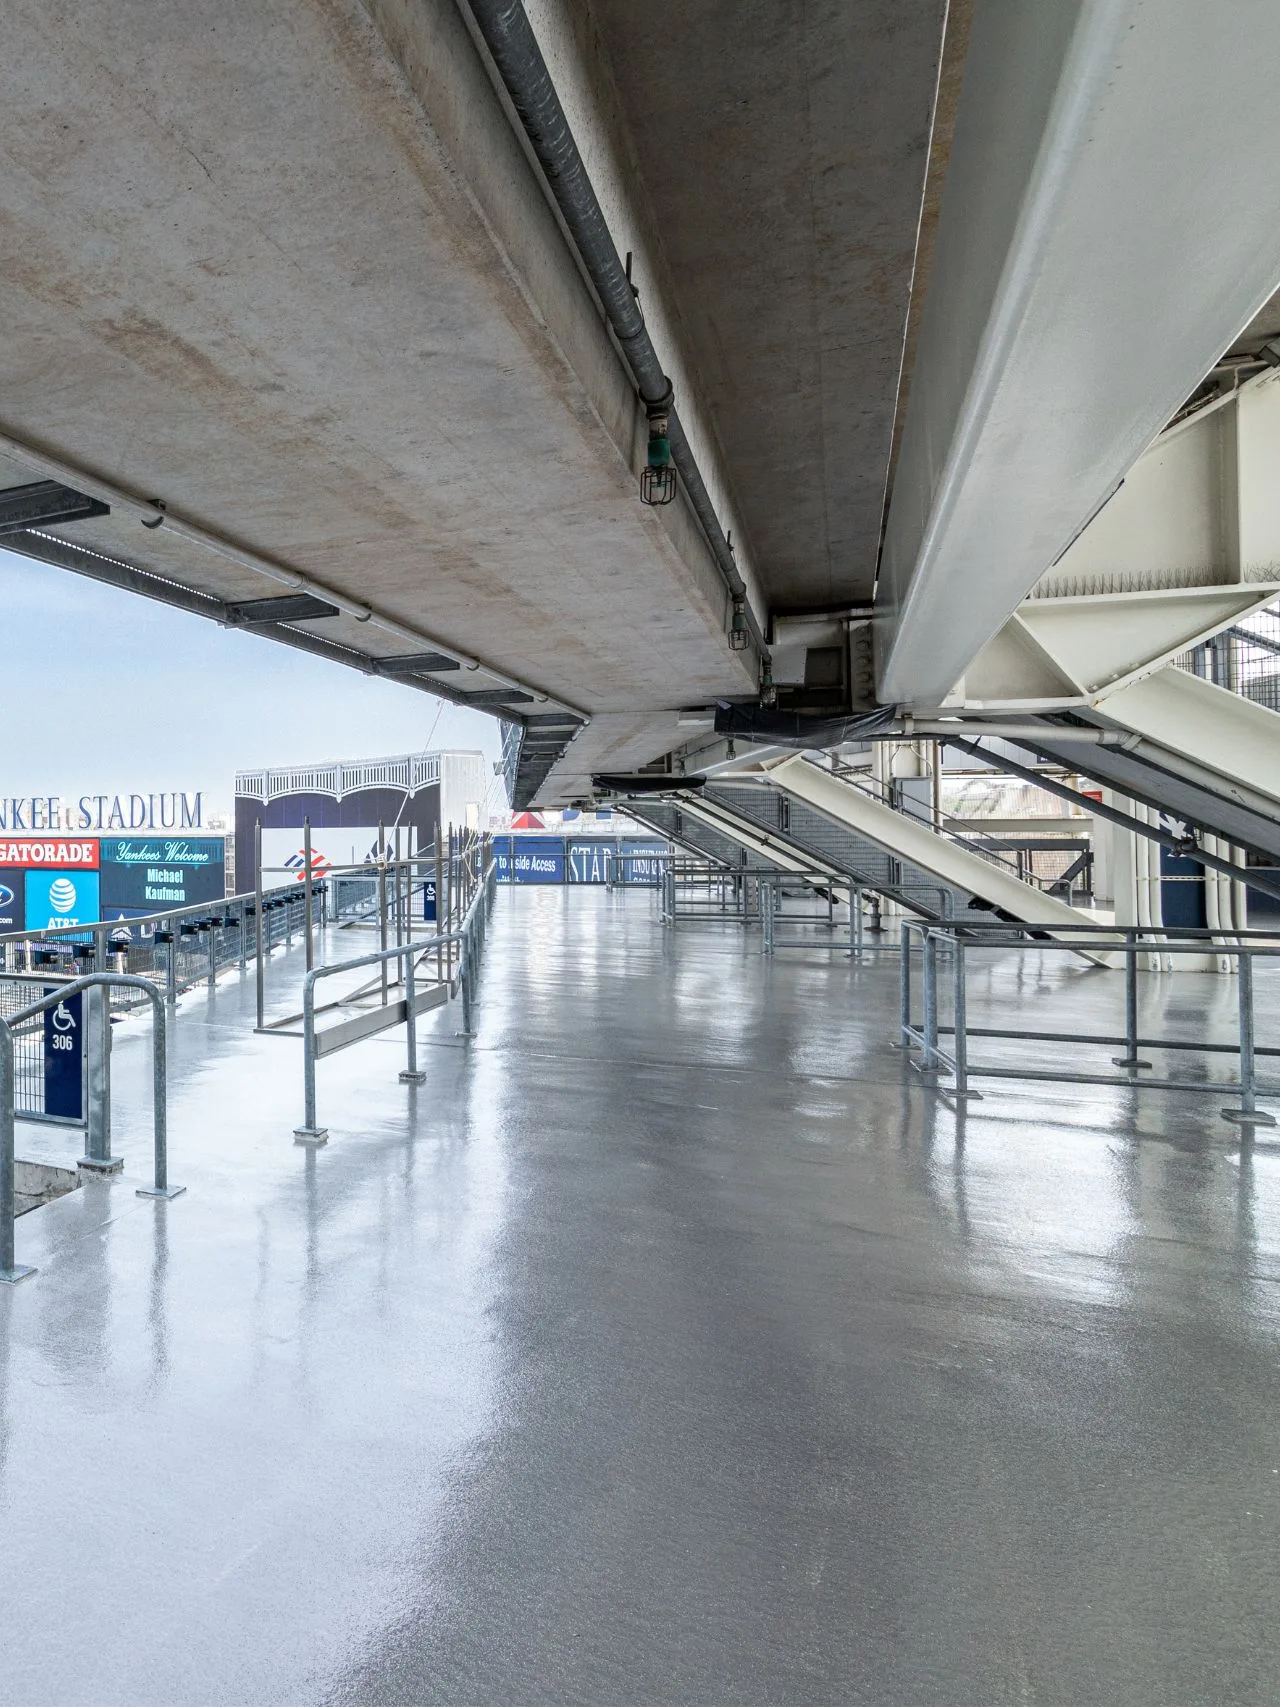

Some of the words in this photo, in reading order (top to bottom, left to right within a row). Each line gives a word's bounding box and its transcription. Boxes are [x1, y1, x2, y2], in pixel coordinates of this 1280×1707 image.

[78, 791, 204, 829] STADIUM
[116, 841, 161, 860] Yankees
[165, 841, 209, 862] Welcome
[531, 855, 556, 872] Access
[147, 868, 184, 883] Michael
[145, 886, 186, 902] Kaufman
[48, 917, 79, 930] AT&T
[52, 1034, 73, 1051] 306
